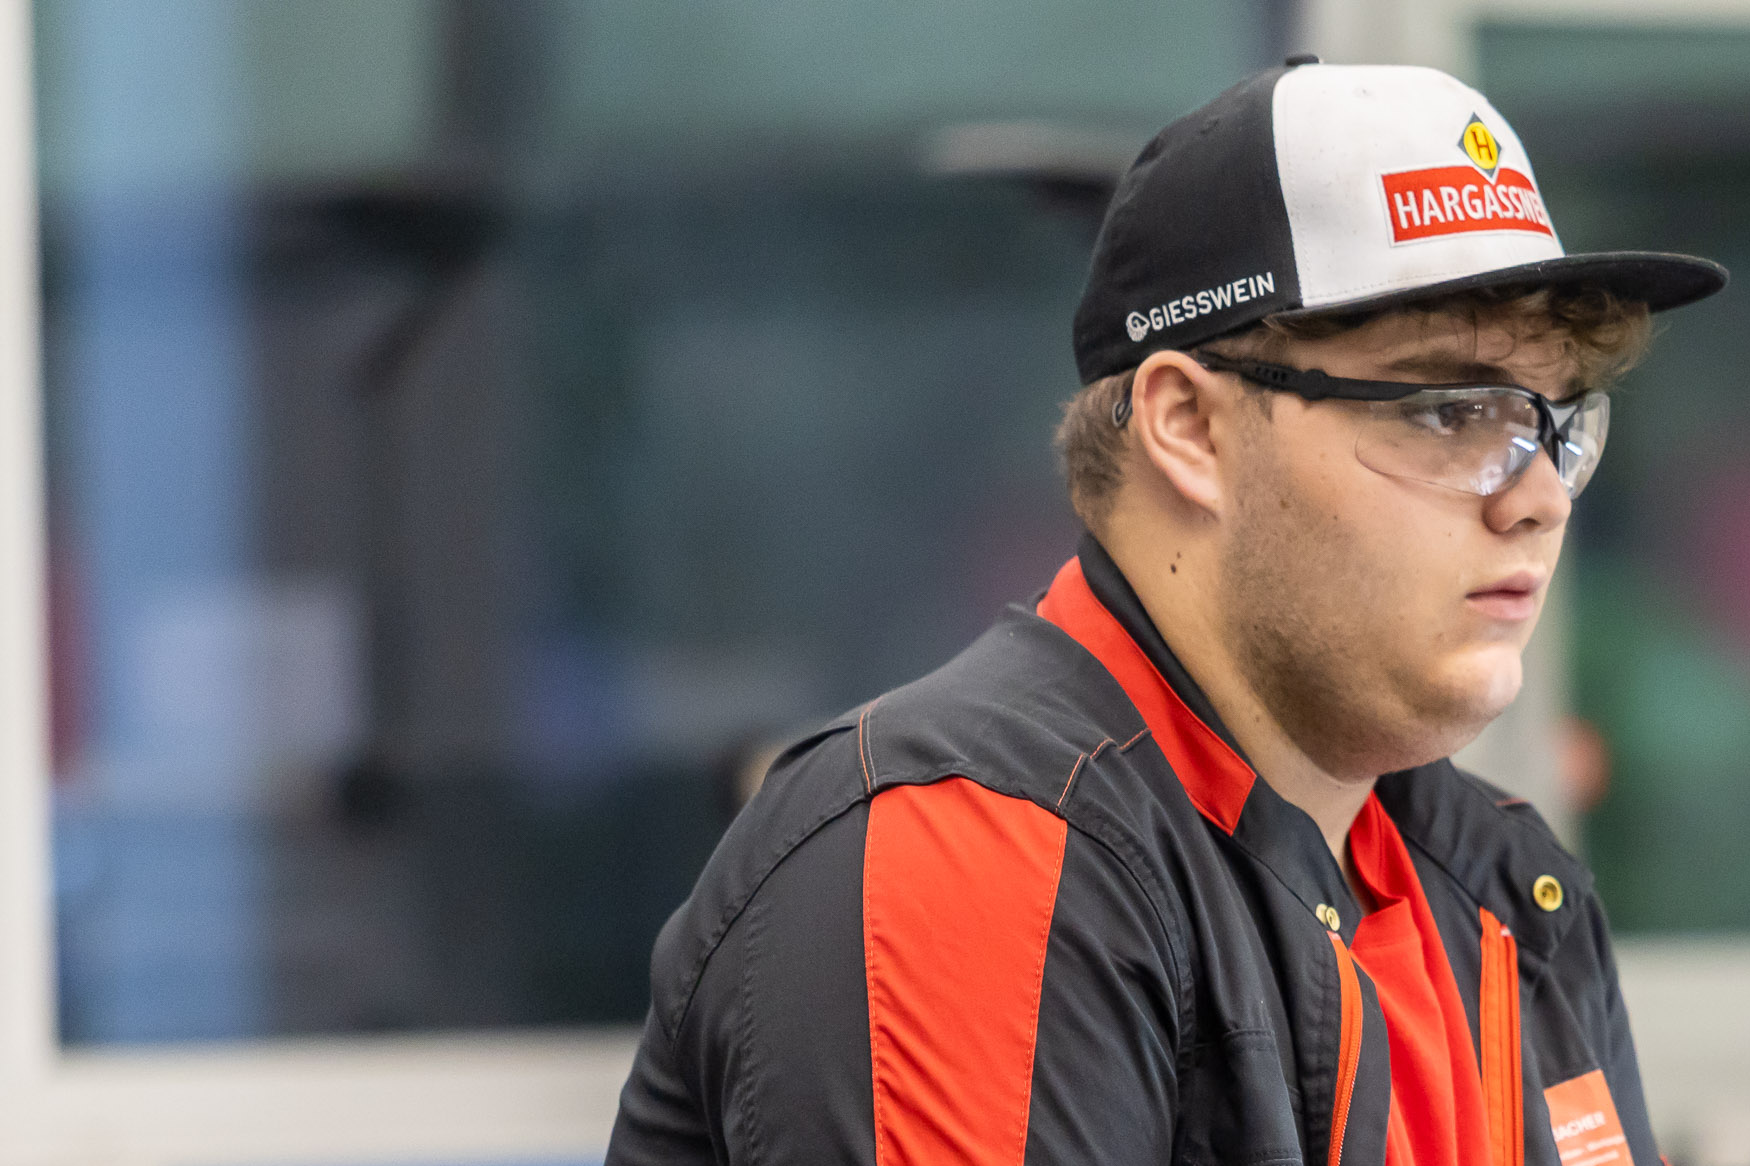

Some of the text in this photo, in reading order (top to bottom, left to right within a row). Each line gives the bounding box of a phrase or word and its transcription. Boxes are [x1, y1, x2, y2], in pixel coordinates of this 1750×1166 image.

[1471, 130, 1493, 161] H
[1393, 184, 1548, 230] HARGASSNE
[1149, 271, 1275, 331] GIESSWEIN
